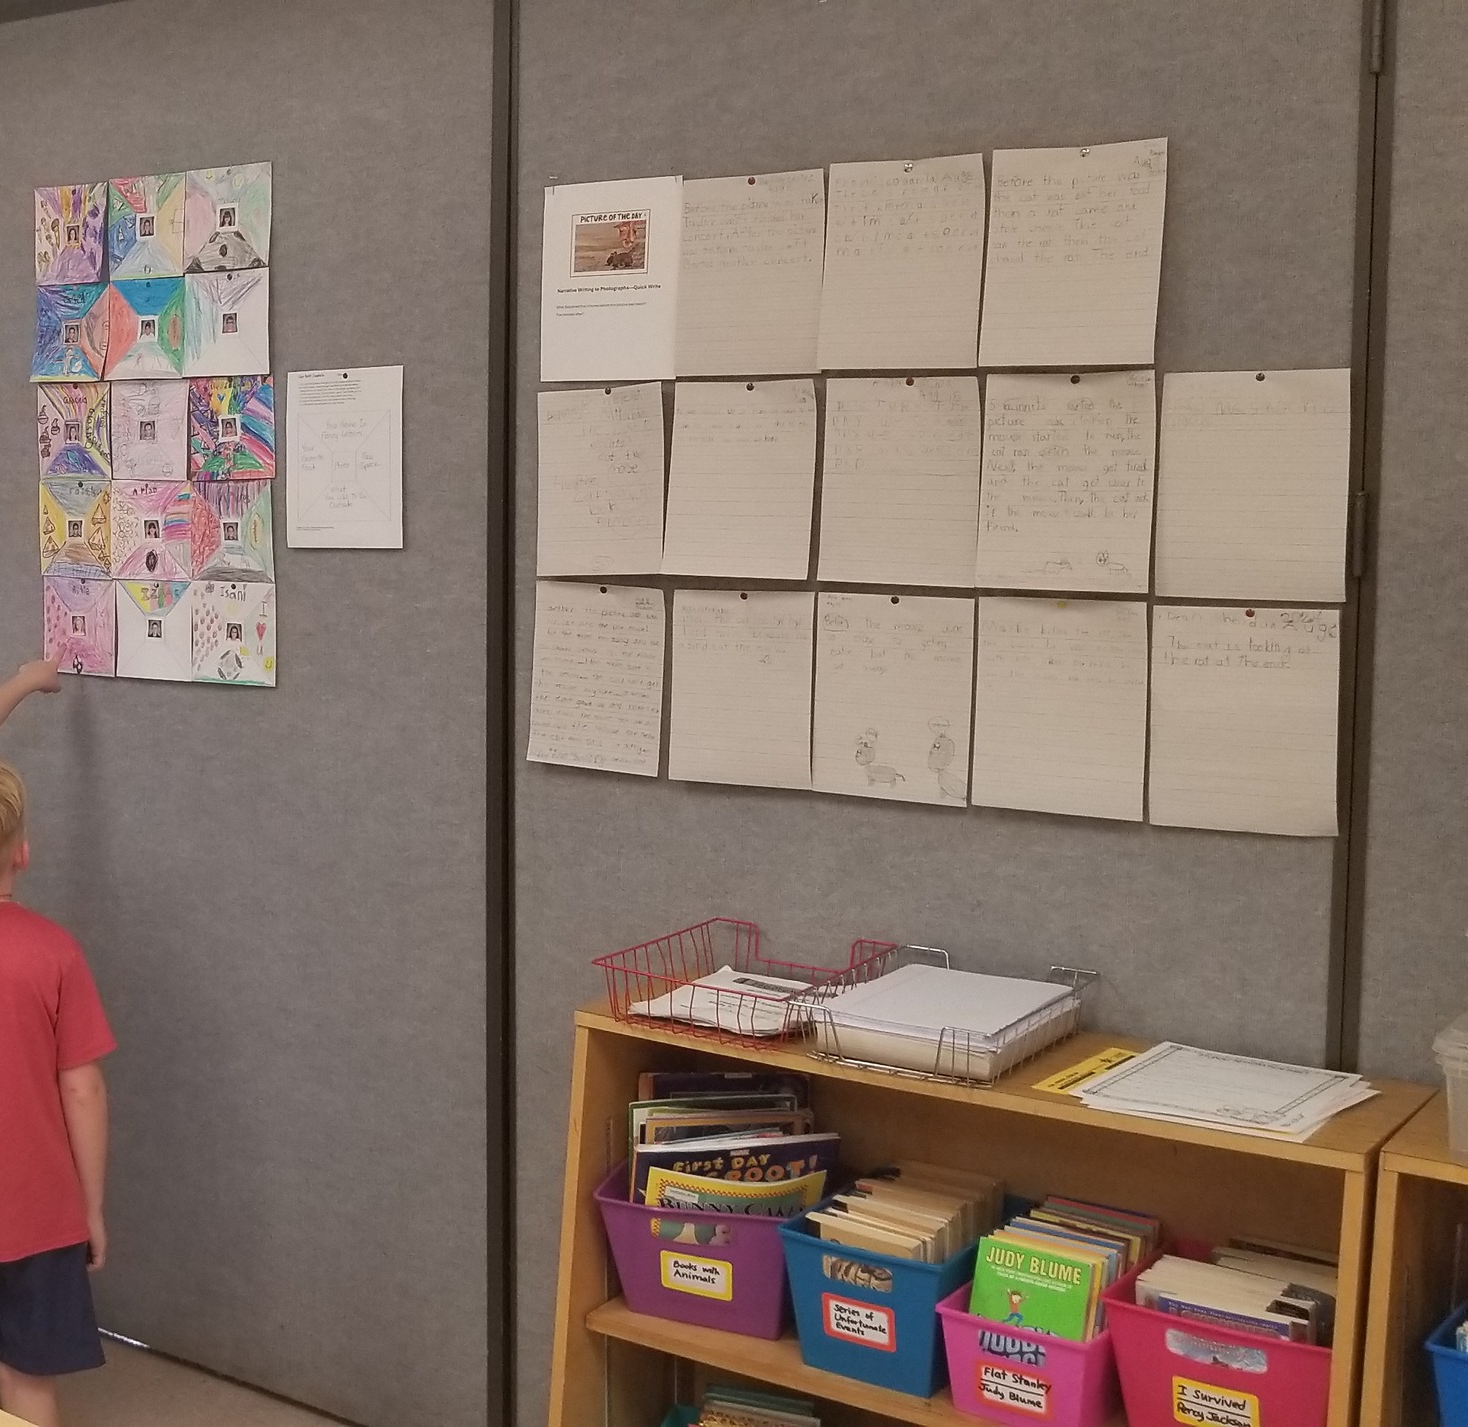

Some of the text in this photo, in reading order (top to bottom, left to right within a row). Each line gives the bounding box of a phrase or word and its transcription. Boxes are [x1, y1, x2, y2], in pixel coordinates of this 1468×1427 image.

[579, 211, 643, 223] PICTURE OF THE DAY
[672, 1152, 772, 1173] First DAY
[673, 1260, 721, 1276] Books with
[985, 1245, 1026, 1270] JUDY
[1029, 1255, 1083, 1286] BLUME
[673, 1268, 716, 1285] Animals
[834, 1312, 887, 1335] Unfortunate
[865, 1311, 875, 1322] of
[835, 1321, 865, 1336] Events
[984, 1366, 1008, 1381] Flat
[978, 1382, 1043, 1409] Judy Blume
[1177, 1384, 1247, 1411] I Survived
[1177, 1401, 1205, 1422] Percy
